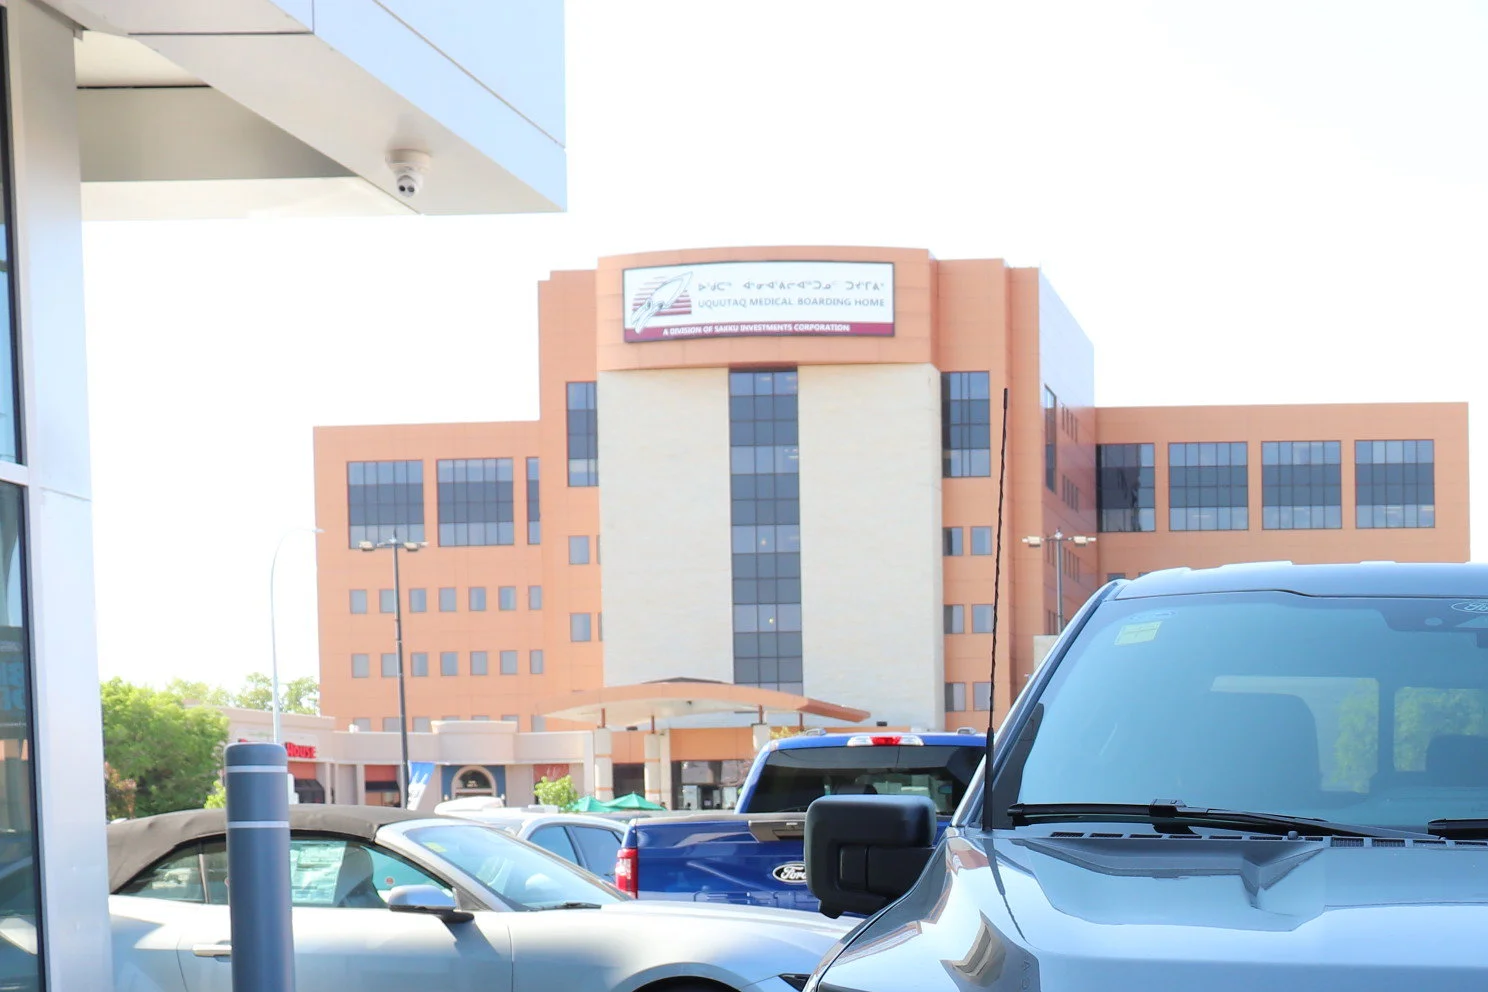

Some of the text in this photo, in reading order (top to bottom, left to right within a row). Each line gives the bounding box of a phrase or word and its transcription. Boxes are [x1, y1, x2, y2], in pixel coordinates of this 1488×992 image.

[698, 297, 885, 308] UQUUTAQ MEDICAL BOARDING HOME
[663, 328, 669, 336] A
[670, 326, 702, 335] DIVISION
[703, 325, 713, 333] OF
[740, 323, 792, 333] INVESTMENTS
[793, 323, 851, 332] CORPORATION
